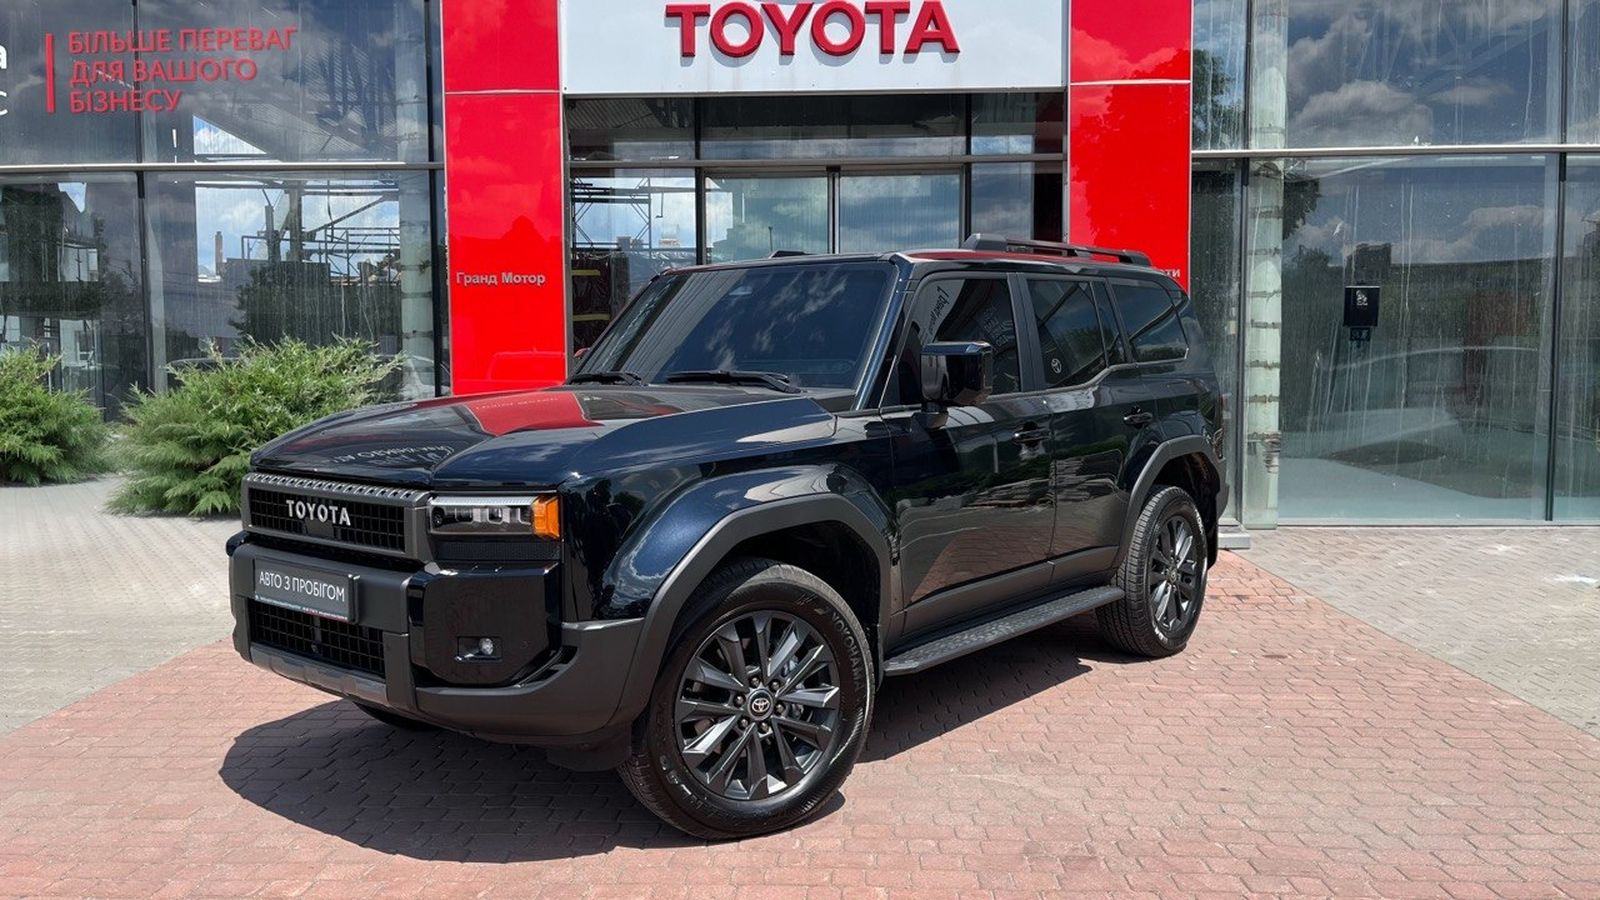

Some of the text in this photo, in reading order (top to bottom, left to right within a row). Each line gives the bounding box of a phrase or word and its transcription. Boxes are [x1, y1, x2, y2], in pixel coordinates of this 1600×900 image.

[69, 26, 298, 53] БІЛЬШЕ ПЕРЕВАГ
[665, 1, 960, 57] TOYOTA
[70, 58, 257, 87] ДЛЯ ВАШОГО
[70, 89, 182, 113] БІЗНЕСУ
[456, 272, 546, 286] Гранд Мотор
[286, 499, 351, 526] TOYOTA
[259, 571, 282, 589] АВТО
[292, 577, 345, 602] ПРОБІГОМ
[831, 611, 865, 693] YOKOHAMA
